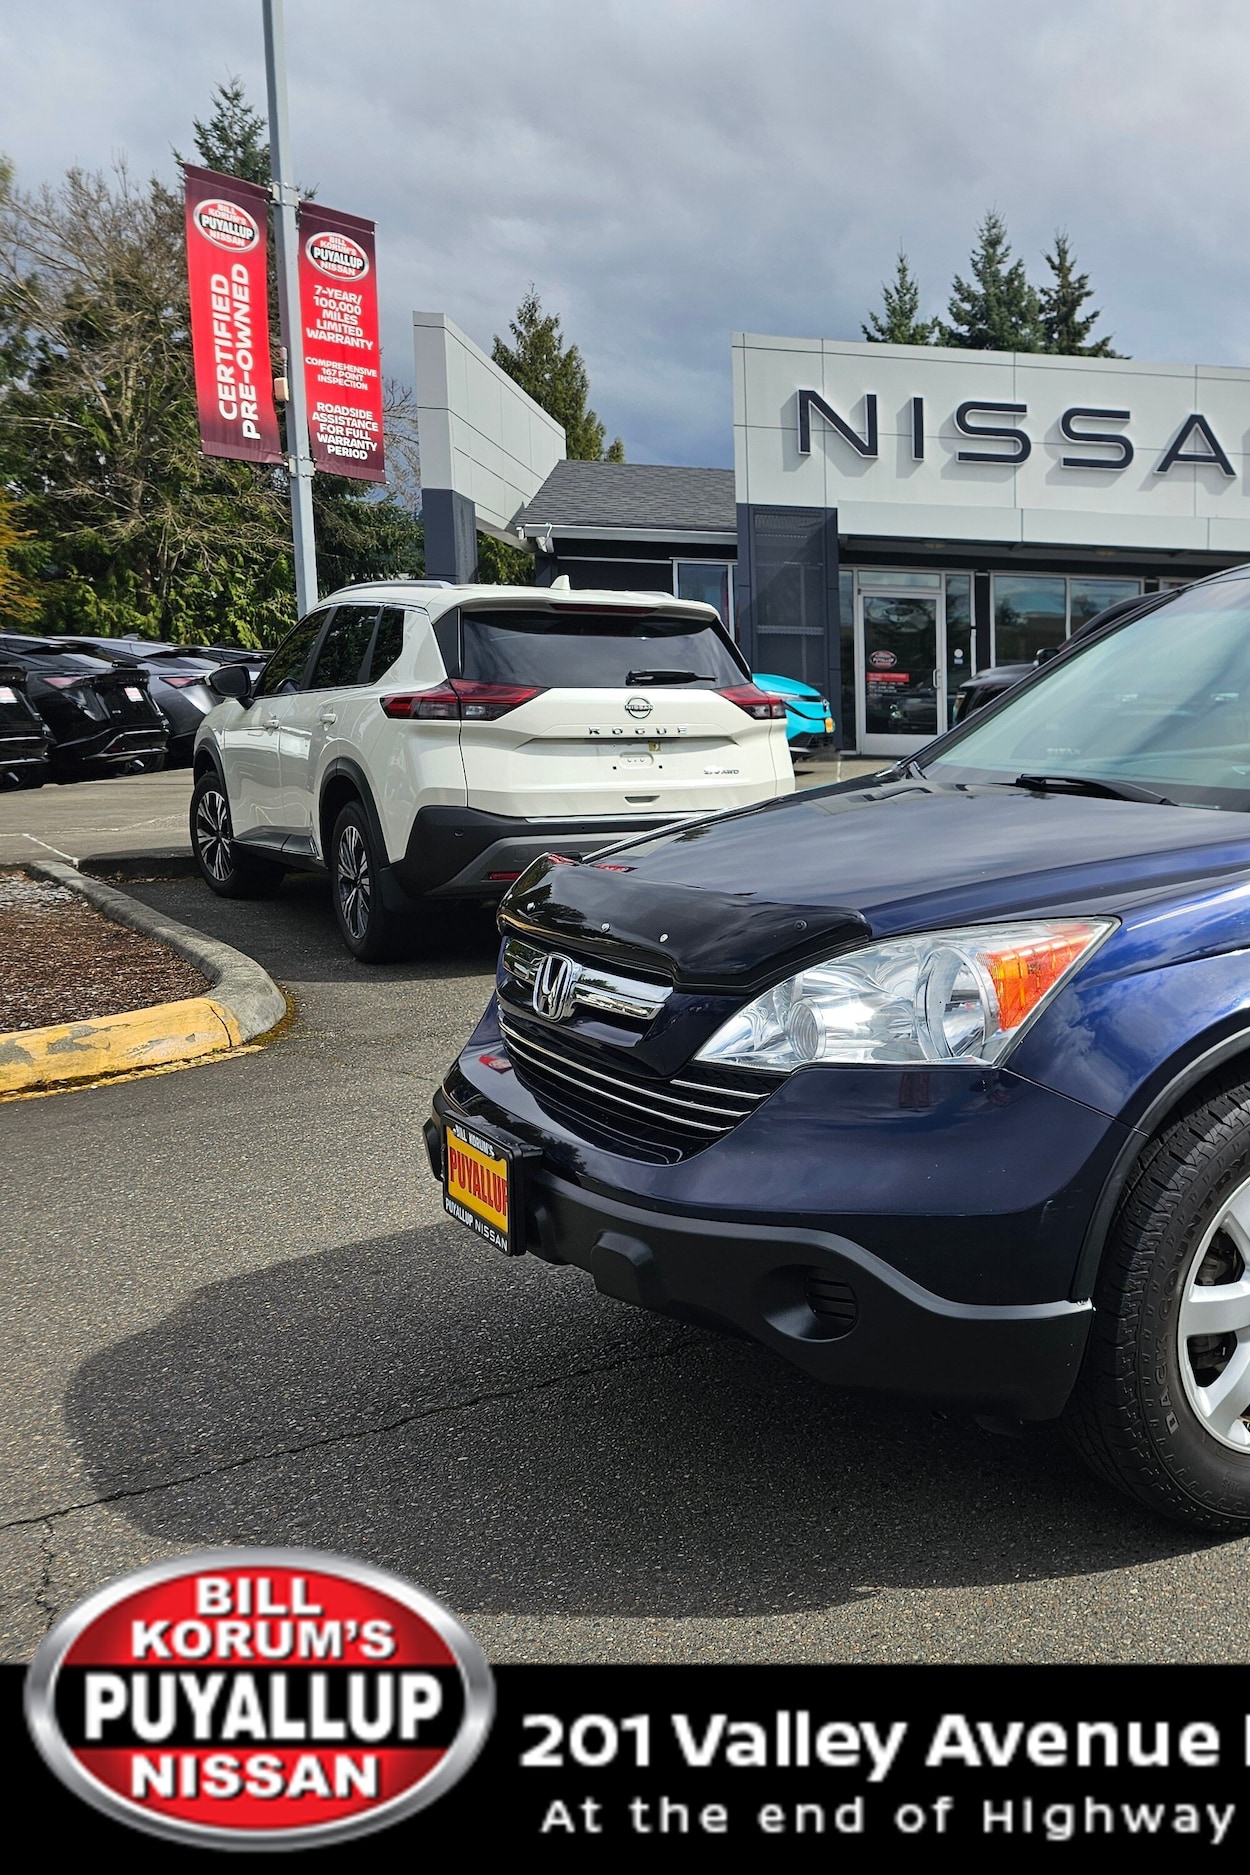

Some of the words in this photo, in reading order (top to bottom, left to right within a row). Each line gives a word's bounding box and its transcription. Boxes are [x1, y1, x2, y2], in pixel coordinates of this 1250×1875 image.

[201, 214, 253, 240] PUYALLUP
[209, 229, 245, 247] NISSAN
[313, 246, 363, 269] PUYALLUP
[321, 261, 355, 276] NISSAN
[314, 284, 362, 305] 7-YEAR/
[313, 296, 362, 316] 100,000
[322, 309, 358, 325] MILES
[316, 318, 363, 337] LIMITED
[210, 273, 238, 421] CERTIFIED
[305, 327, 373, 351] WARRANTY
[231, 263, 261, 440] PRE-OWNED
[305, 356, 378, 377] COMPREHENSIVE
[338, 368, 364, 382] POINT
[317, 374, 368, 390] INSPECTION
[316, 401, 374, 421] ROADSIDE
[312, 411, 379, 432] ASSISTANCE
[316, 432, 378, 451] WARRANTY
[319, 423, 345, 436] FOR
[345, 427, 371, 441] FULL
[327, 444, 368, 460] PERIOD
[588, 727, 688, 736] ROGUE
[445, 1197, 474, 1226] PUYALLUP
[474, 1219, 508, 1252] NISSAN
[1155, 1332, 1180, 1436] BACK
